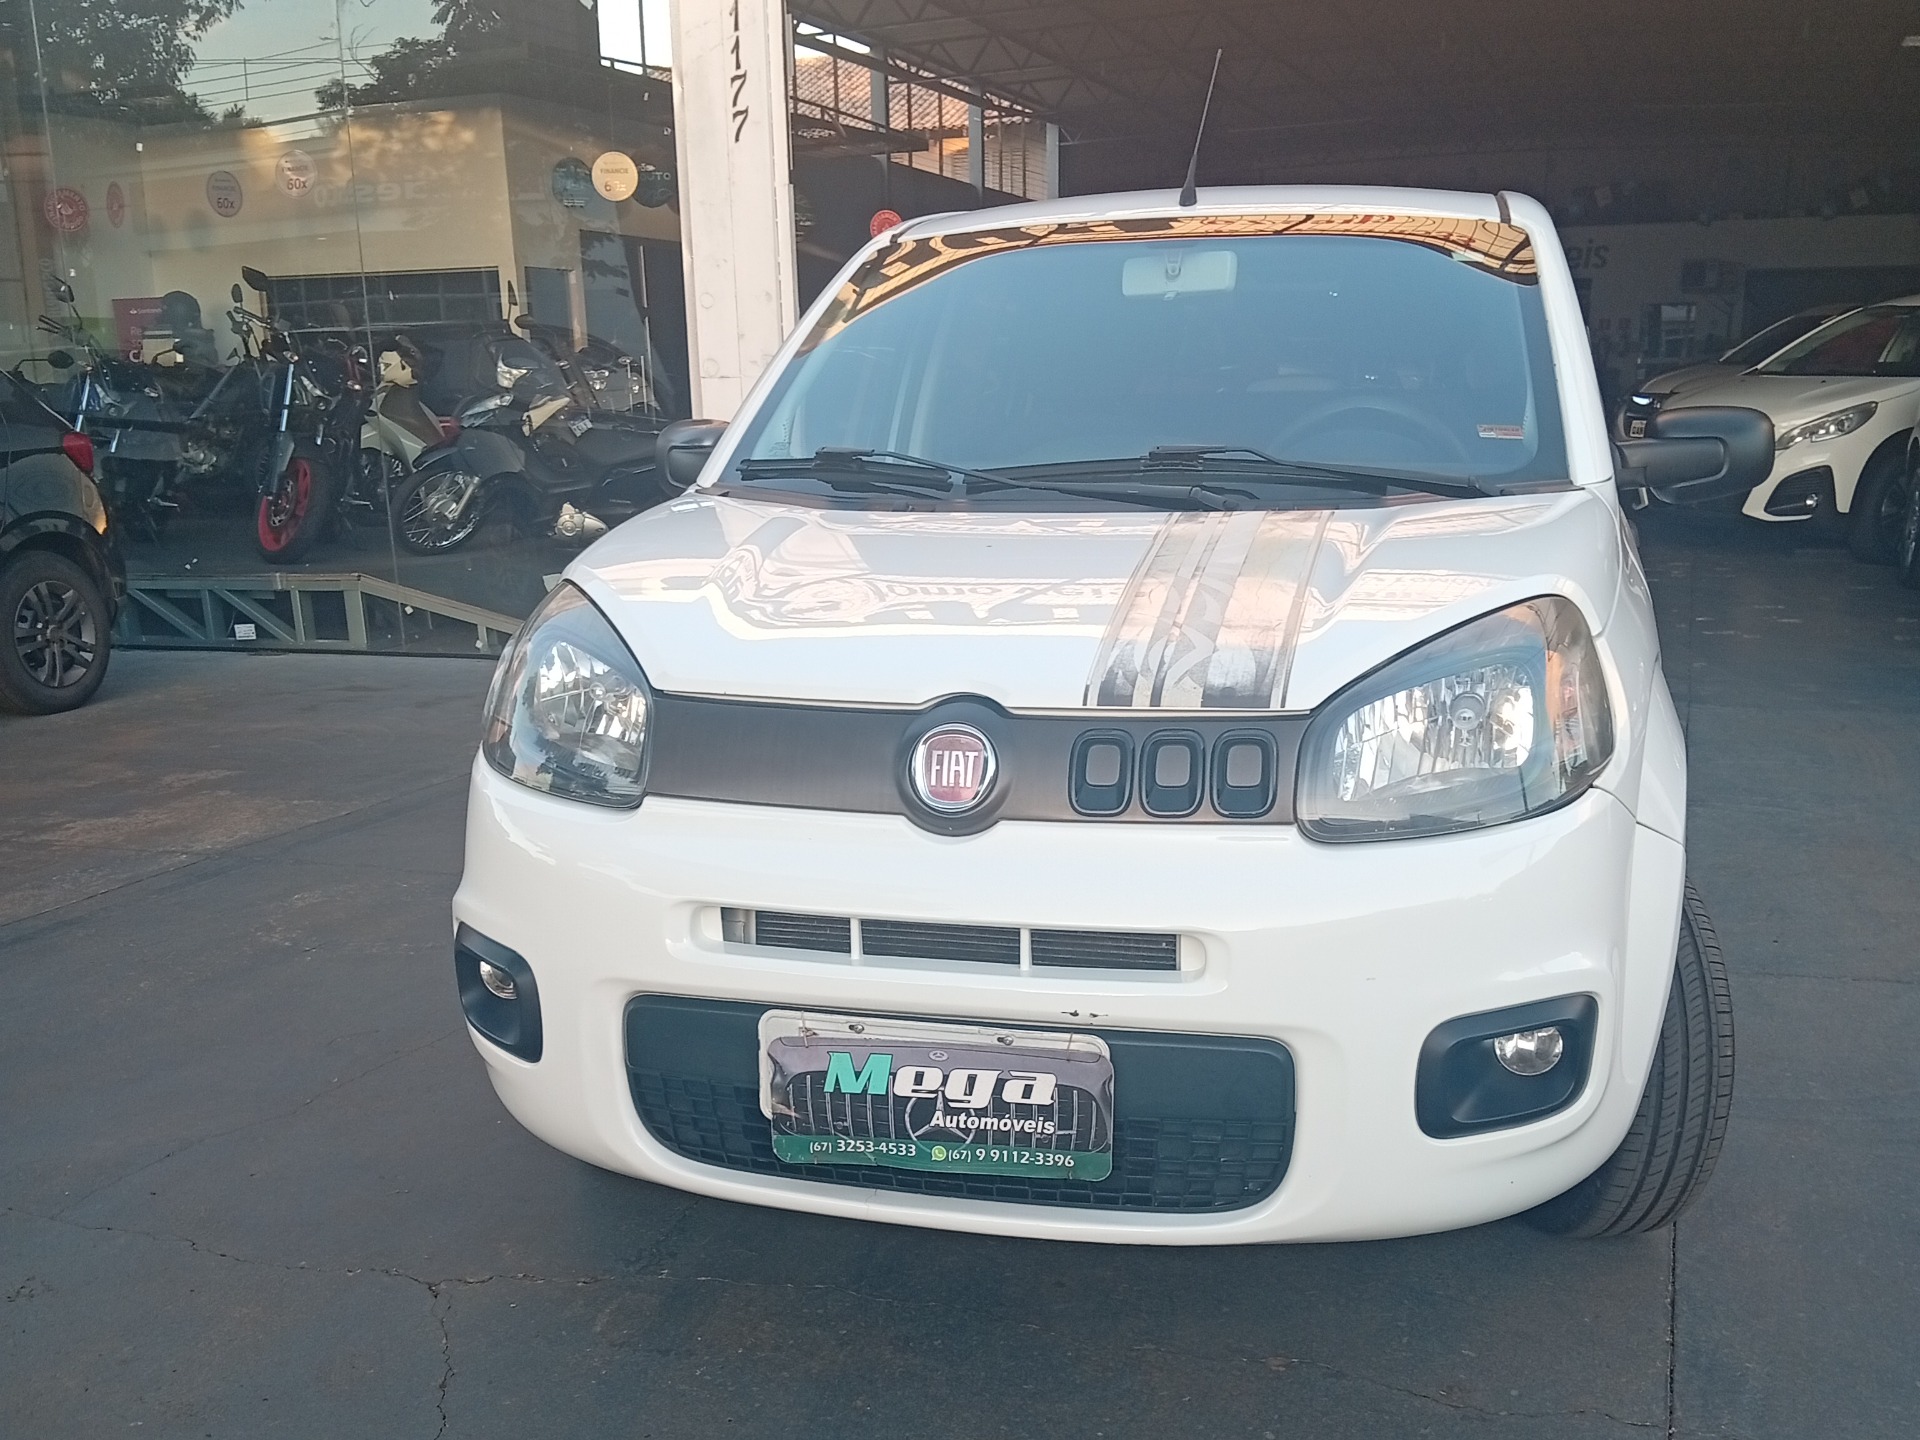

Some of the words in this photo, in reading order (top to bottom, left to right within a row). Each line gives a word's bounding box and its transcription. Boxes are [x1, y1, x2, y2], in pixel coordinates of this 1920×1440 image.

[729, 0, 749, 143] 1177
[287, 178, 308, 190] 60x
[217, 197, 235, 209] 60x
[930, 750, 979, 788] FIAT
[823, 1051, 1057, 1109] Mega
[929, 1110, 1056, 1134] Automóveis
[809, 1141, 832, 1154] (67)
[836, 1139, 916, 1157] 3253-4533
[948, 1149, 972, 1163] (67)
[975, 1148, 986, 1161] 9
[990, 1150, 1075, 1168] 9112-3396
